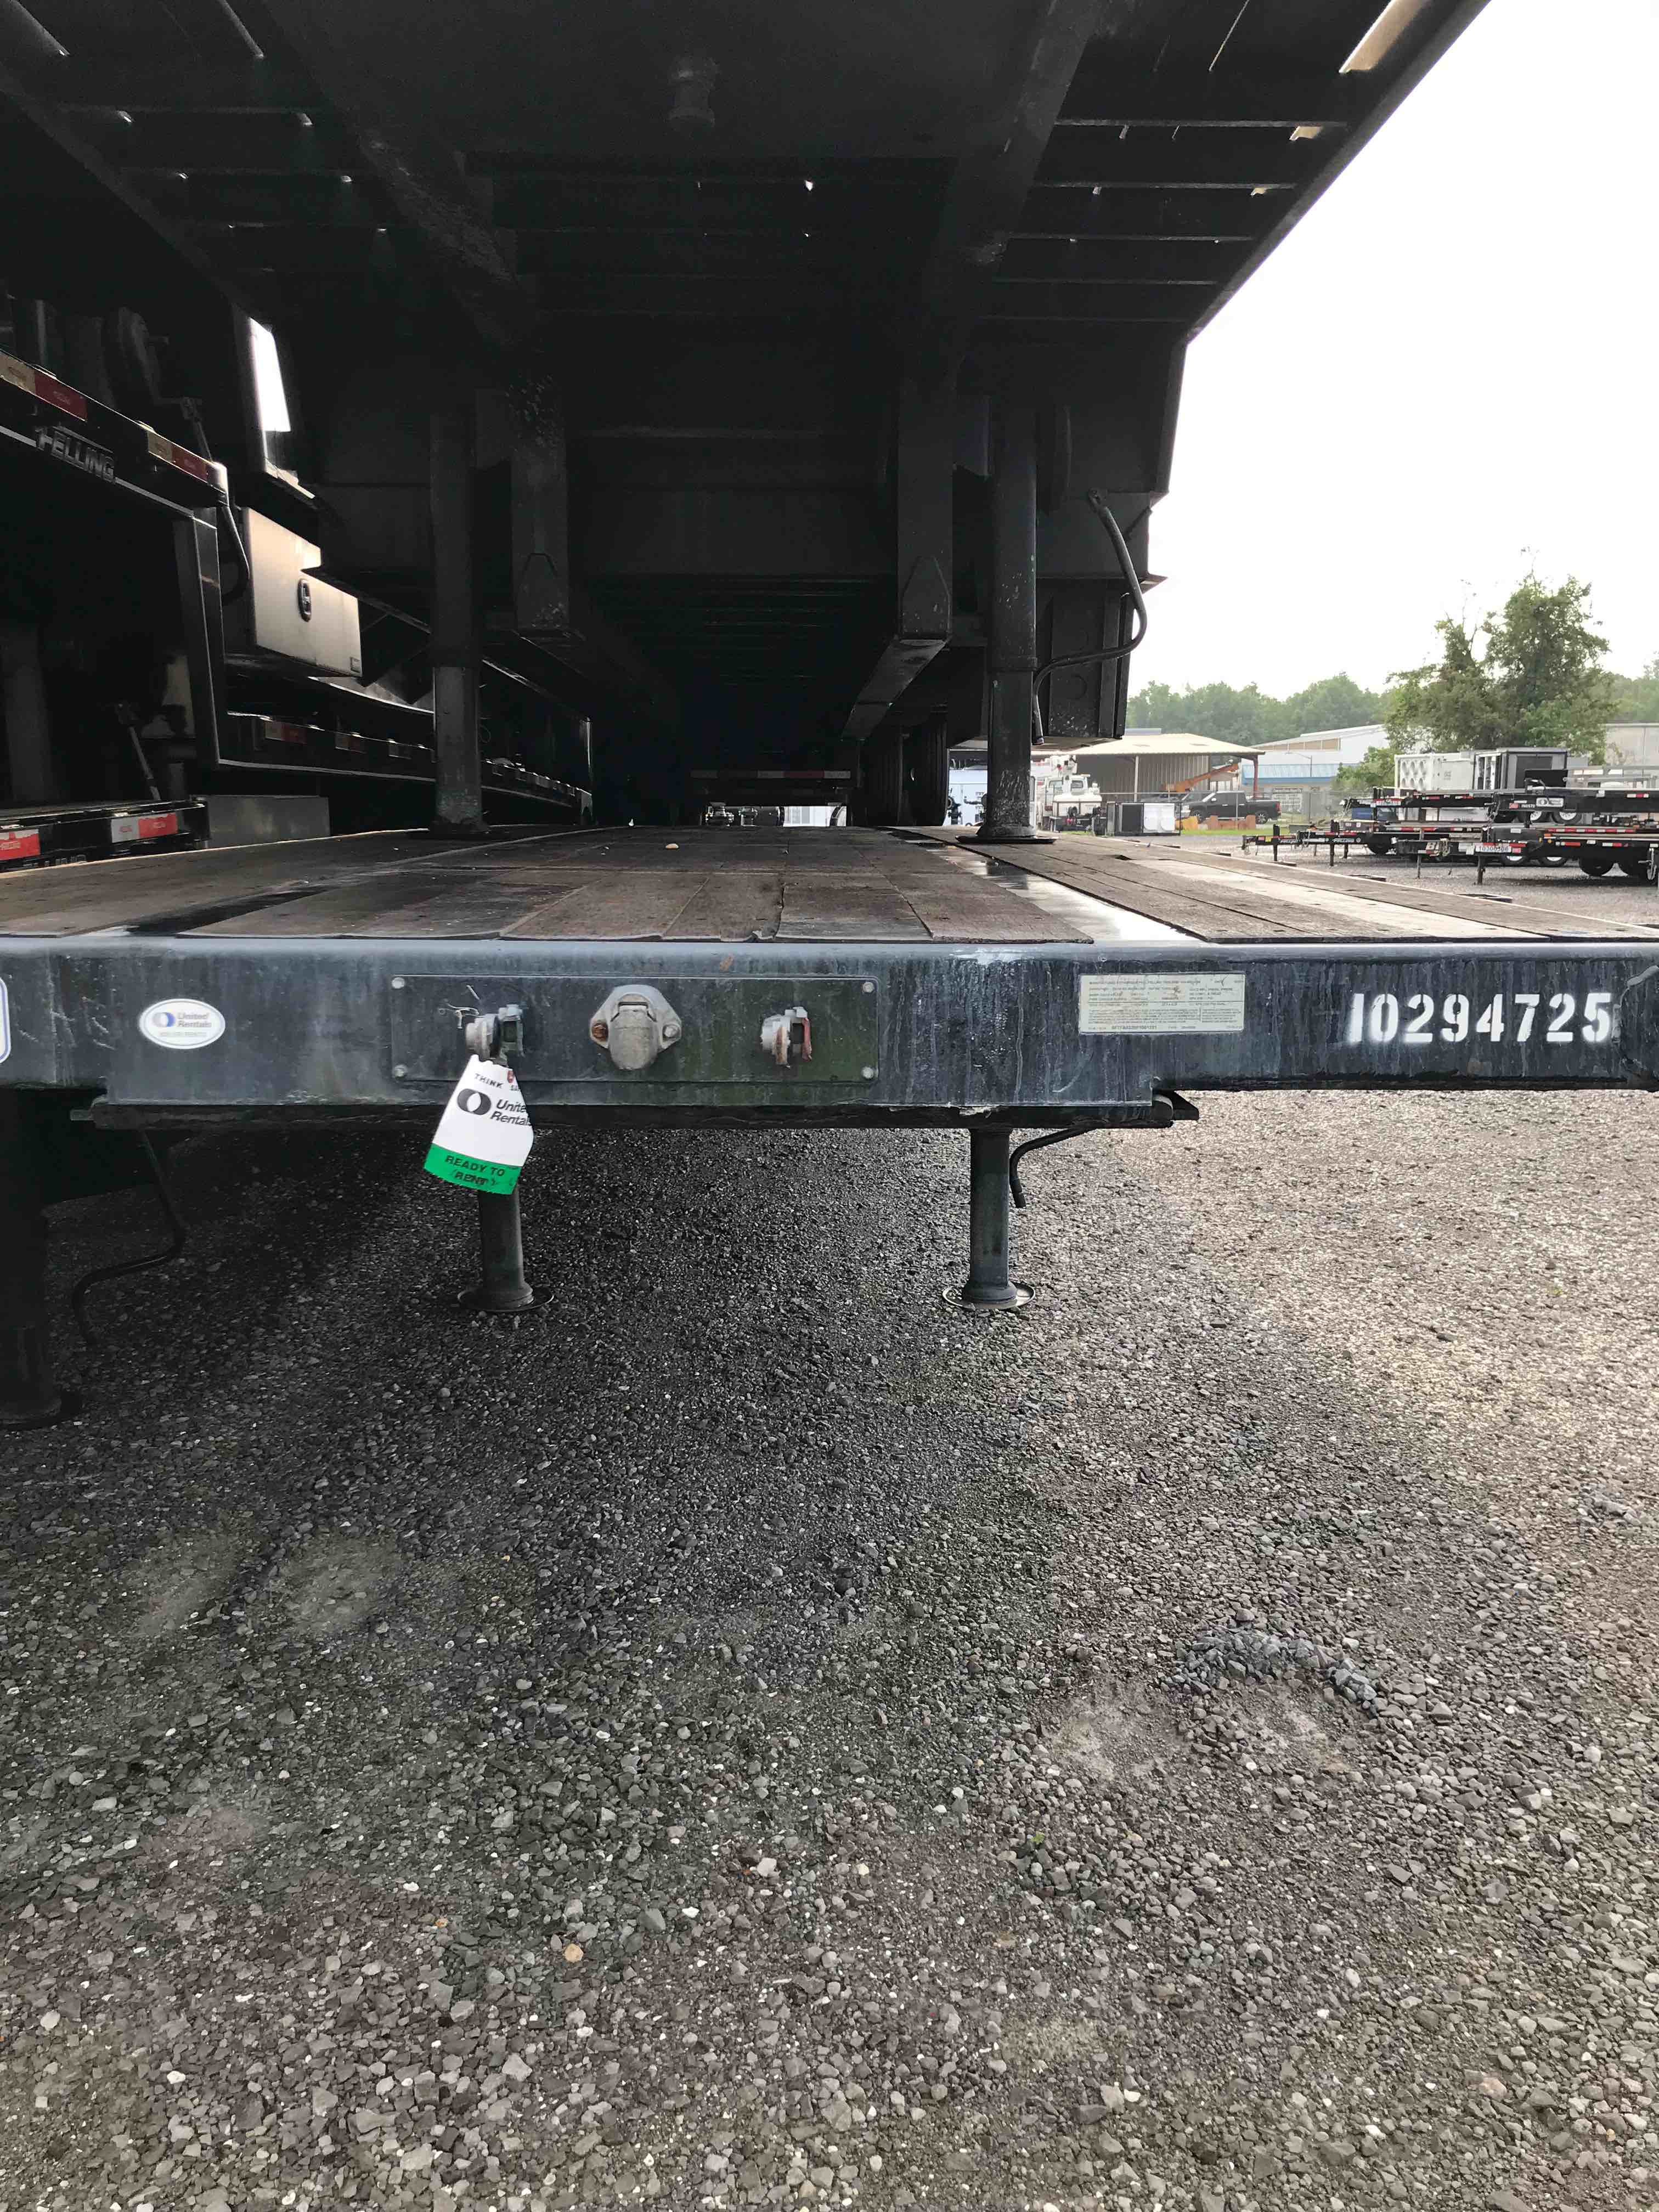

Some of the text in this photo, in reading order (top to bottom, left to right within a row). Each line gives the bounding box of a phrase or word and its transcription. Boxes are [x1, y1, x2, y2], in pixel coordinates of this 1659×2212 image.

[34, 426, 115, 483] FELLING
[1347, 992, 1613, 1043] 10294725
[474, 1073, 504, 1088] THINK
[496, 1099, 527, 1113] Unite
[444, 1155, 505, 1177] READY TO
[454, 1171, 489, 1186] RENT
